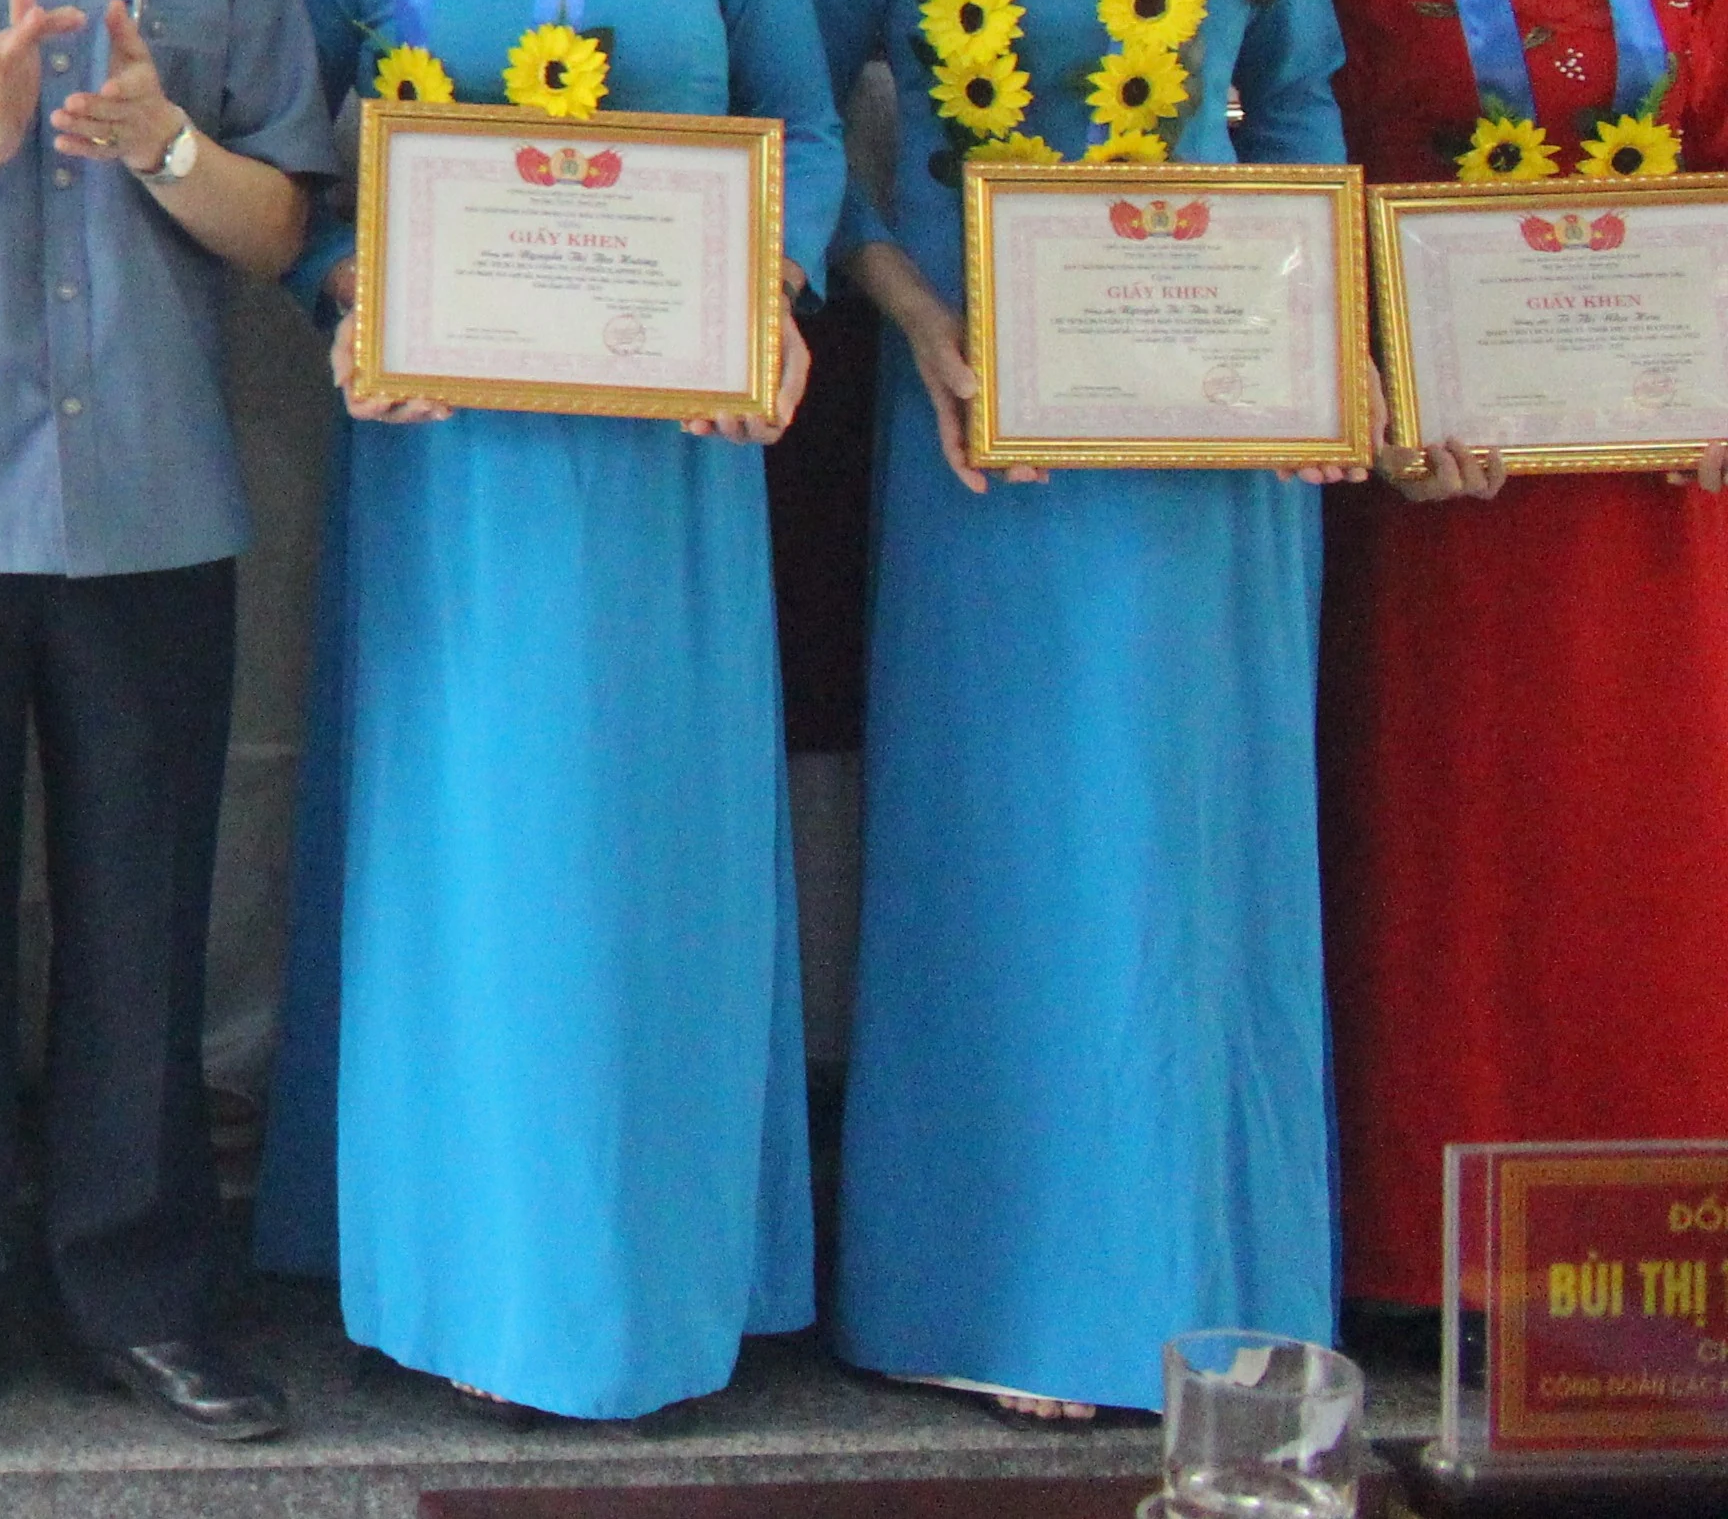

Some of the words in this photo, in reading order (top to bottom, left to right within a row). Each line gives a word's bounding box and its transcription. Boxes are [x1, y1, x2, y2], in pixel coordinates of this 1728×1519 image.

[567, 232, 630, 250] KHEN
[1162, 285, 1219, 300] KHEN
[1637, 1258, 1709, 1328] THỊ
